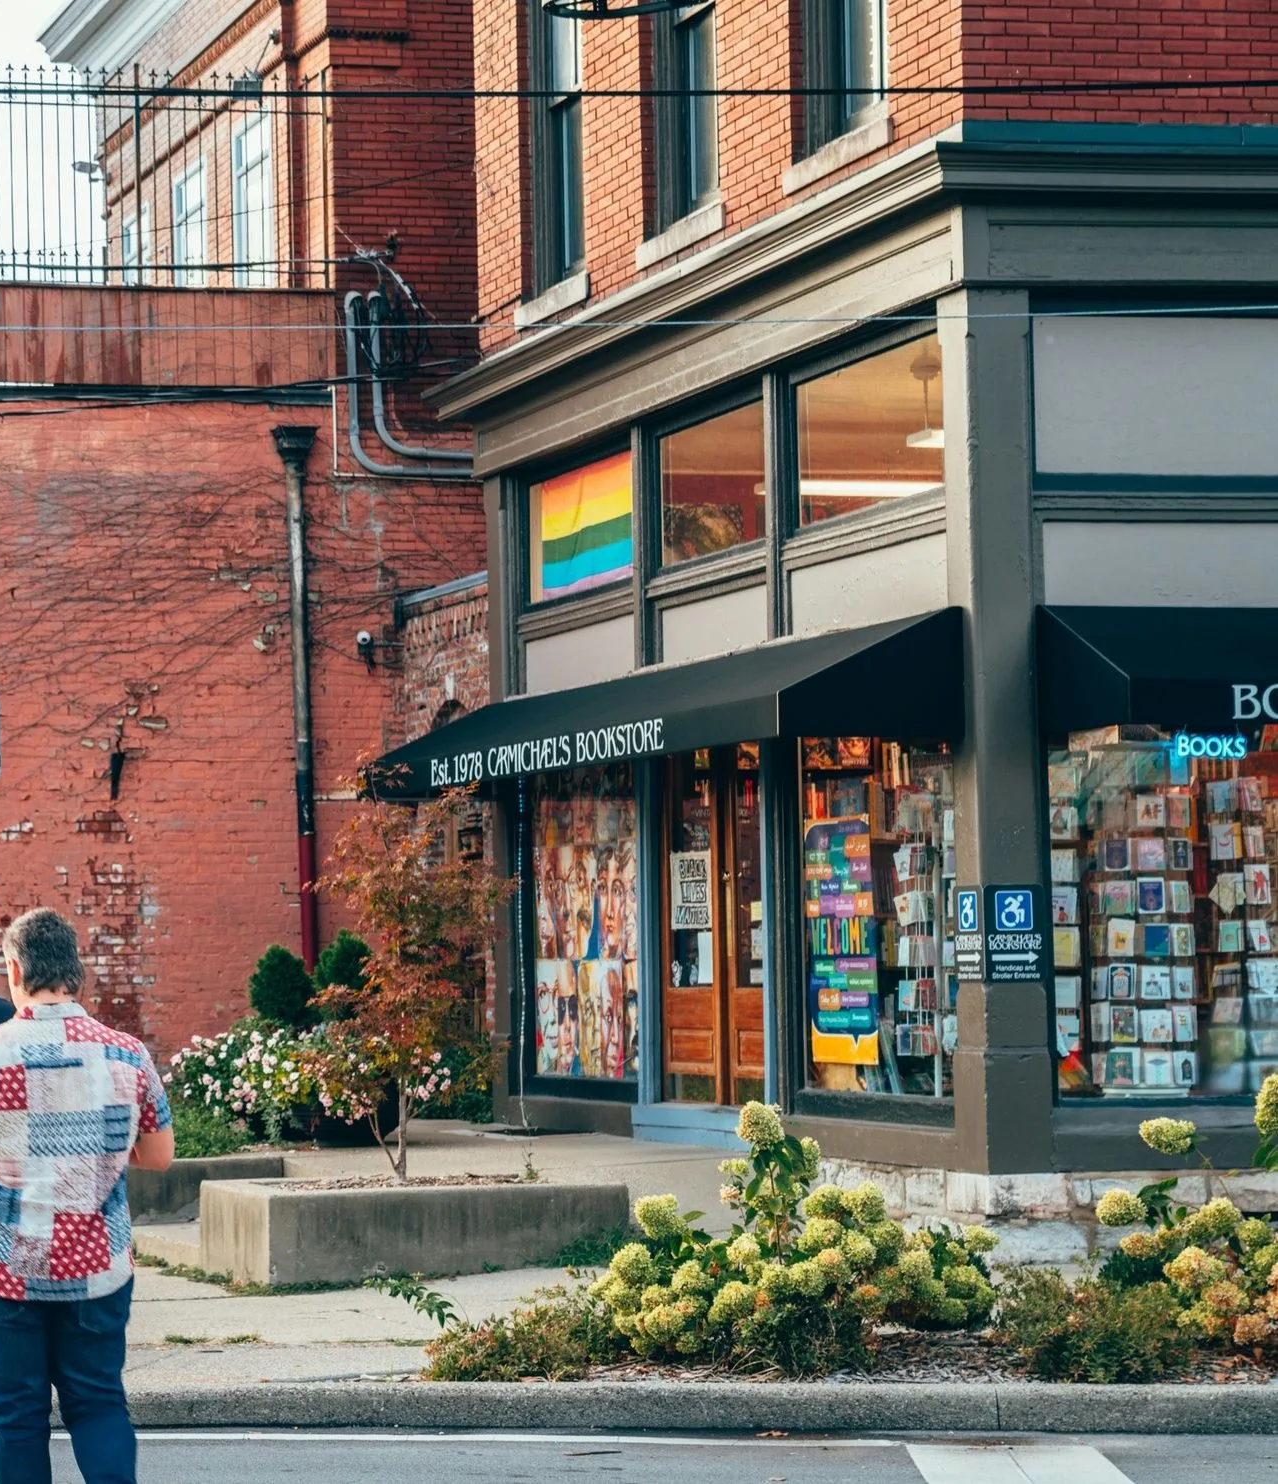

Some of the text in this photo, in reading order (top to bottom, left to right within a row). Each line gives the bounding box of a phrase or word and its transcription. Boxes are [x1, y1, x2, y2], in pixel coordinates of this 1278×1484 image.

[431, 758, 452, 786] Est.
[453, 750, 483, 783] 1978
[576, 718, 664, 763] BOOKSTORE
[1177, 735, 1246, 758] BOOKS
[679, 859, 707, 879] BLACK
[681, 881, 707, 903] LIVES
[675, 905, 710, 924] MATTER
[811, 917, 870, 955] WELCOME
[989, 941, 1042, 951] BOOKSTORE
[995, 964, 1023, 972] Handicap
